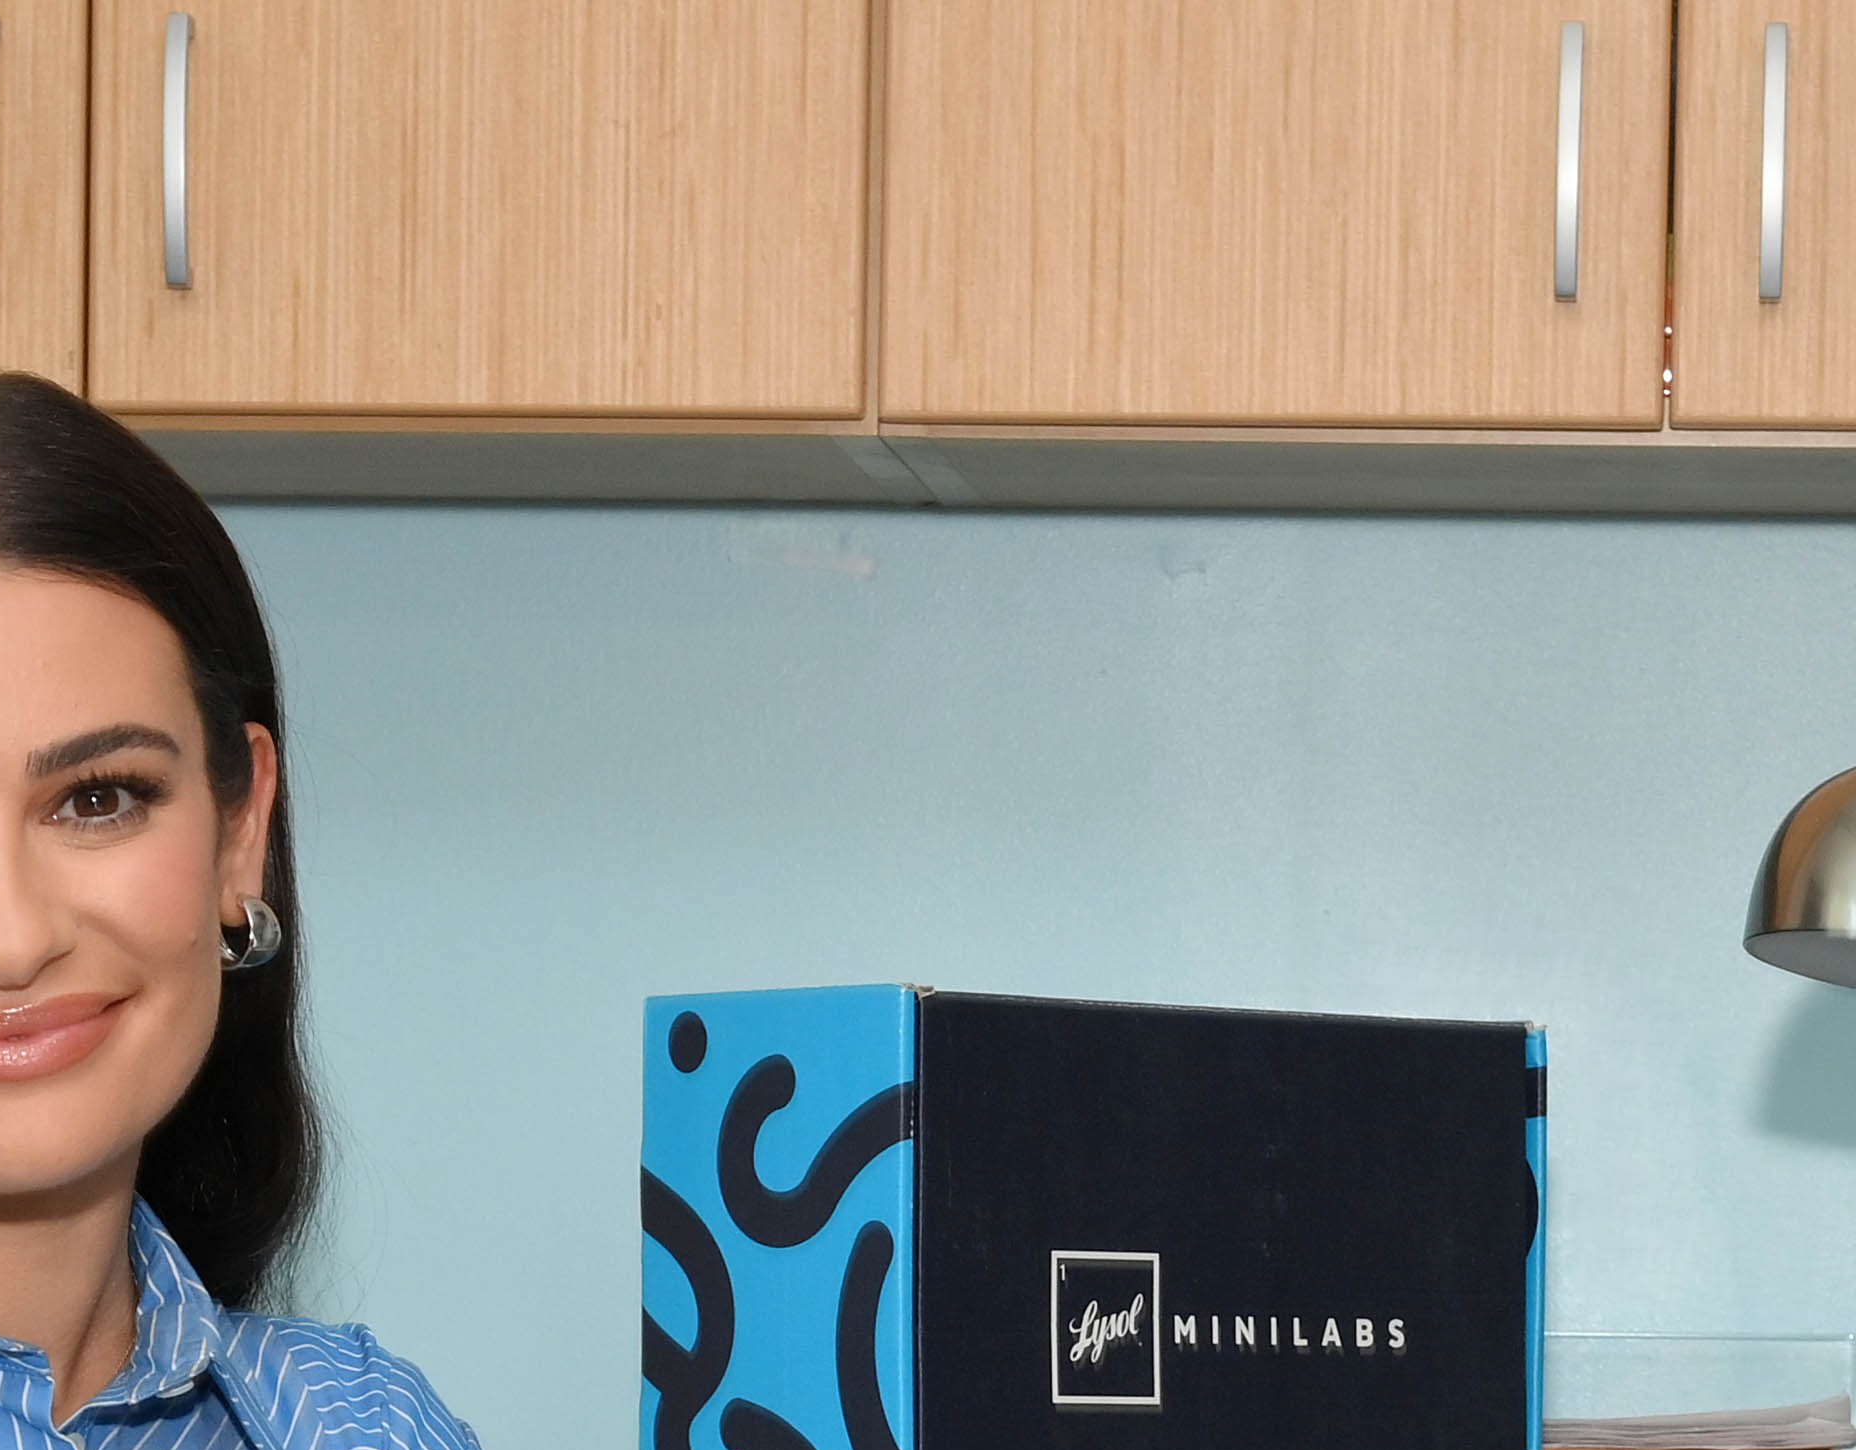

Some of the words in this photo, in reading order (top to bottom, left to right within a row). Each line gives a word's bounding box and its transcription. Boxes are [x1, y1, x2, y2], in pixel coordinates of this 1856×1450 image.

[1059, 1263, 1067, 1282] 1
[1069, 1293, 1143, 1363] Lysol
[1173, 1314, 1406, 1349] MINILABS
